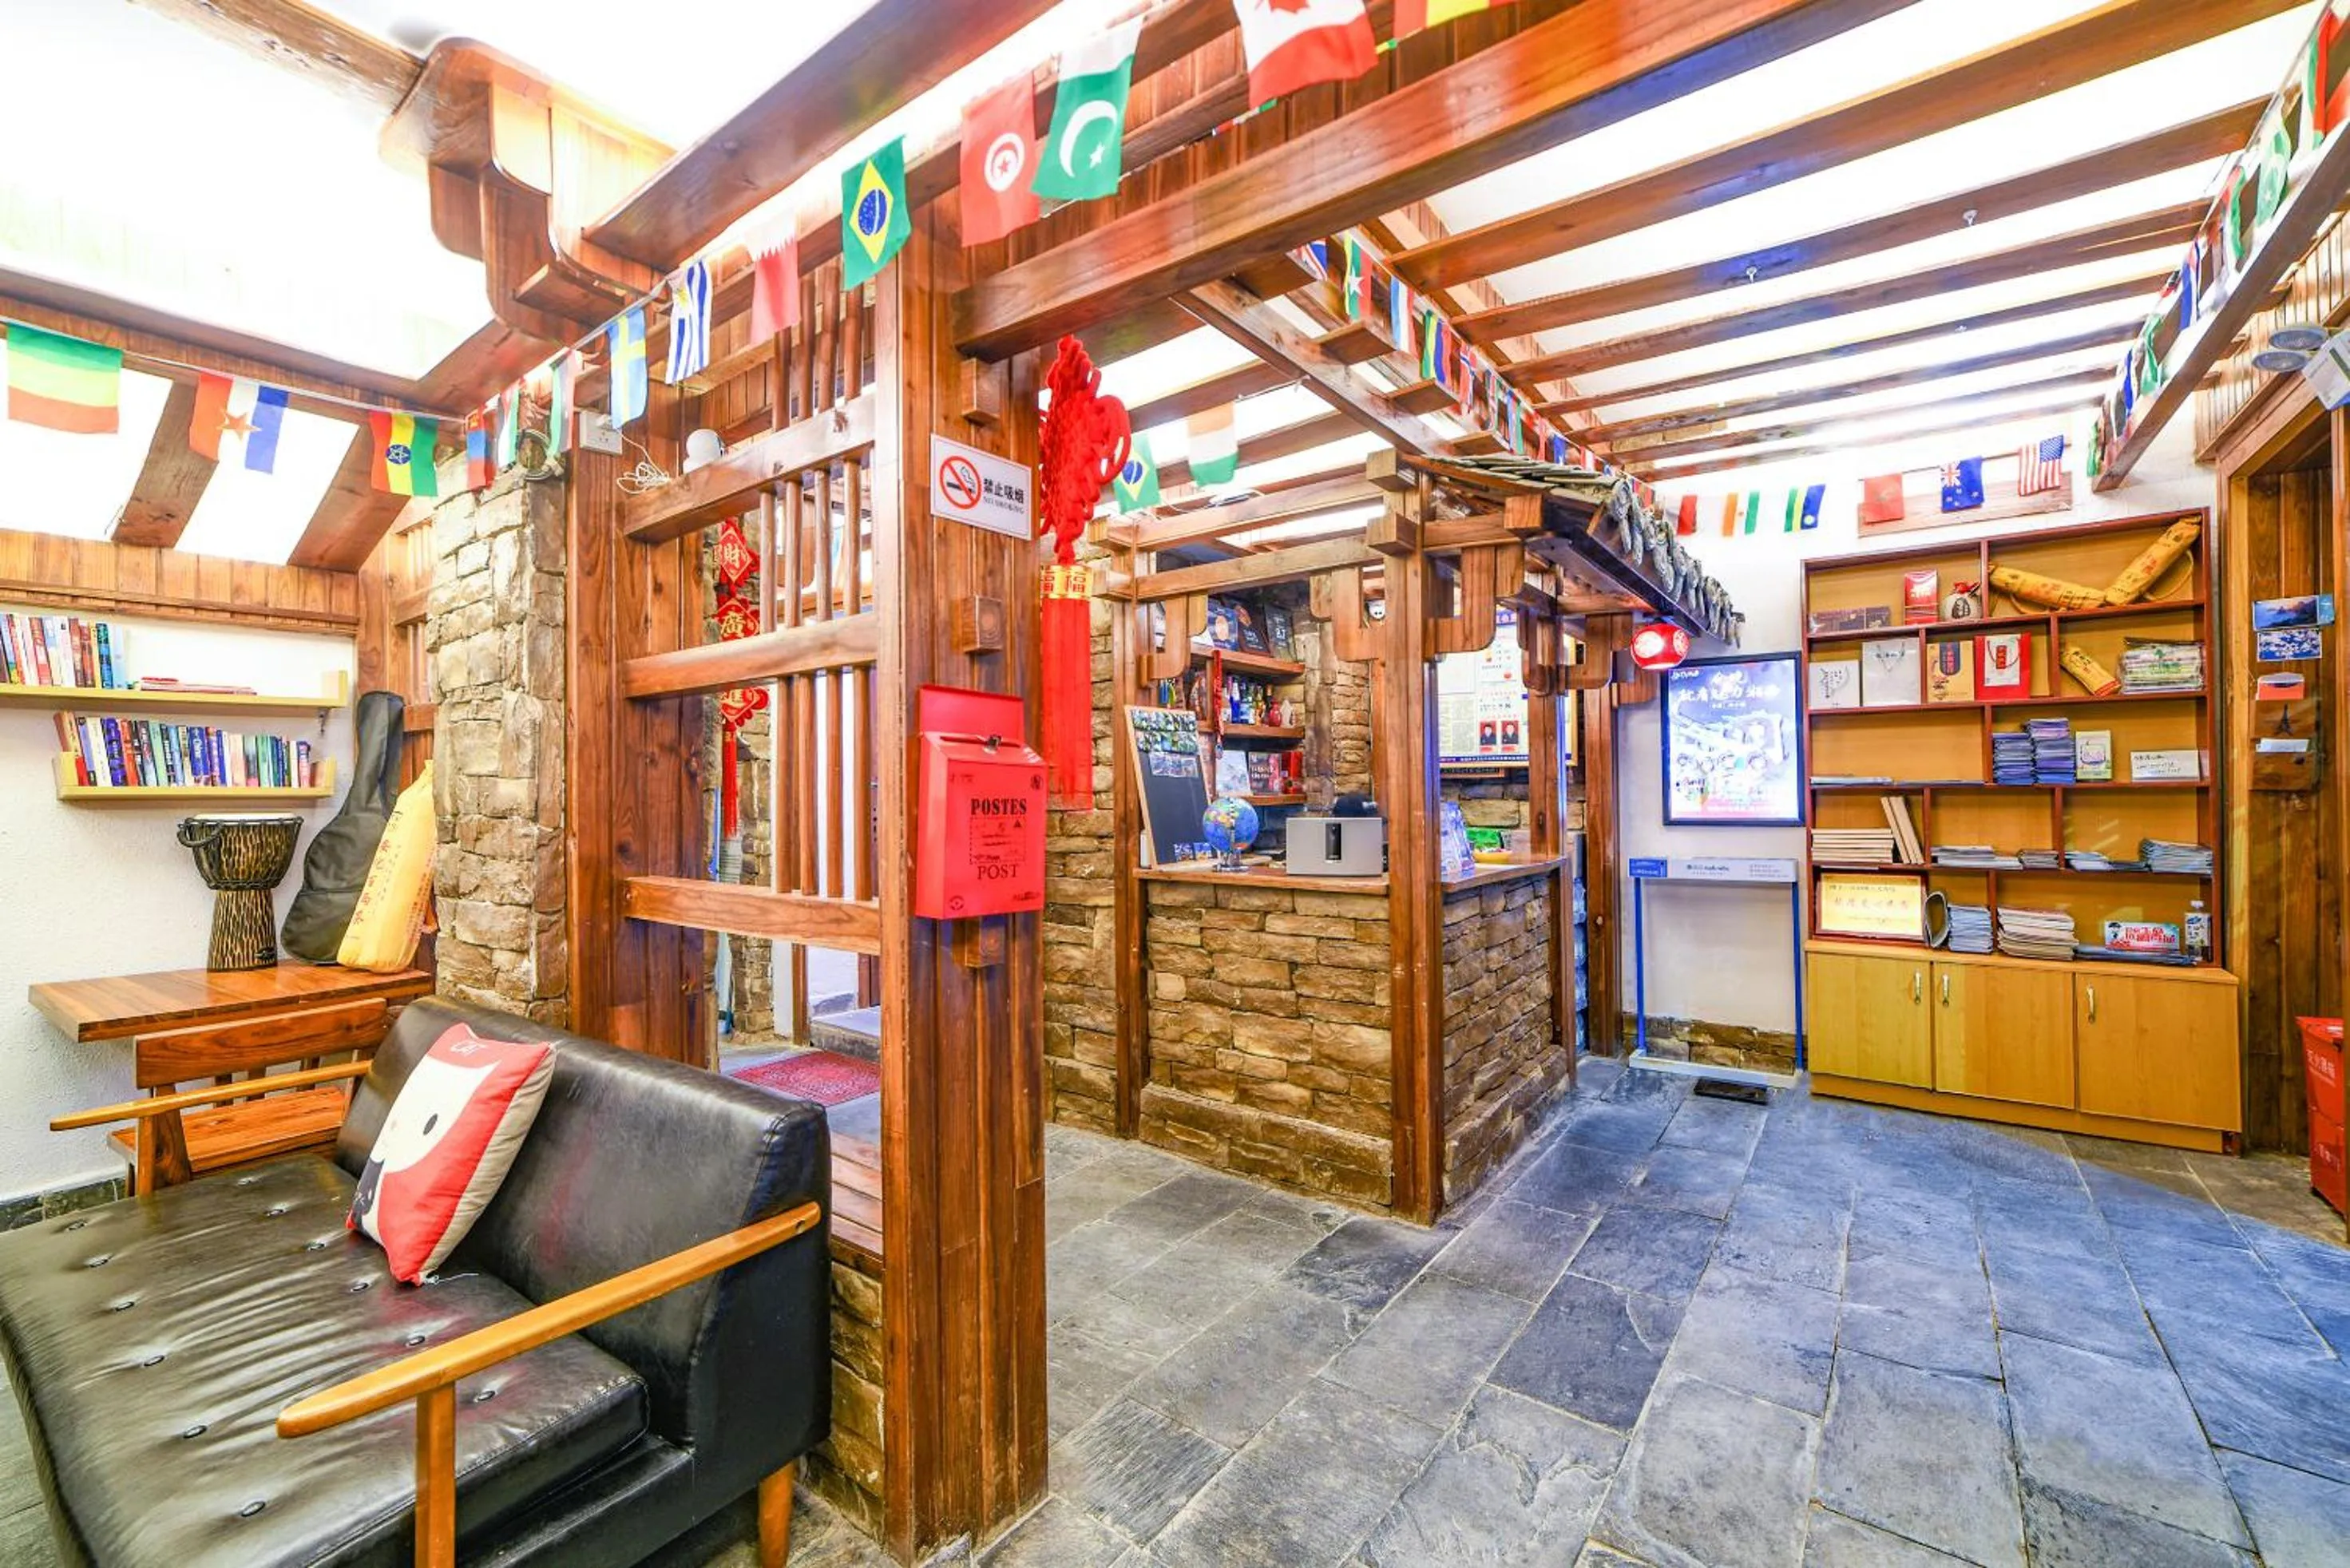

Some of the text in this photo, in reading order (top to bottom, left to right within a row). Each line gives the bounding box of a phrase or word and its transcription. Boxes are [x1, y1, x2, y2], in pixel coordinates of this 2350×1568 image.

[983, 477, 1024, 504] 禁止吸烟
[970, 798, 1027, 815] POSTES
[977, 864, 1019, 880] POST
